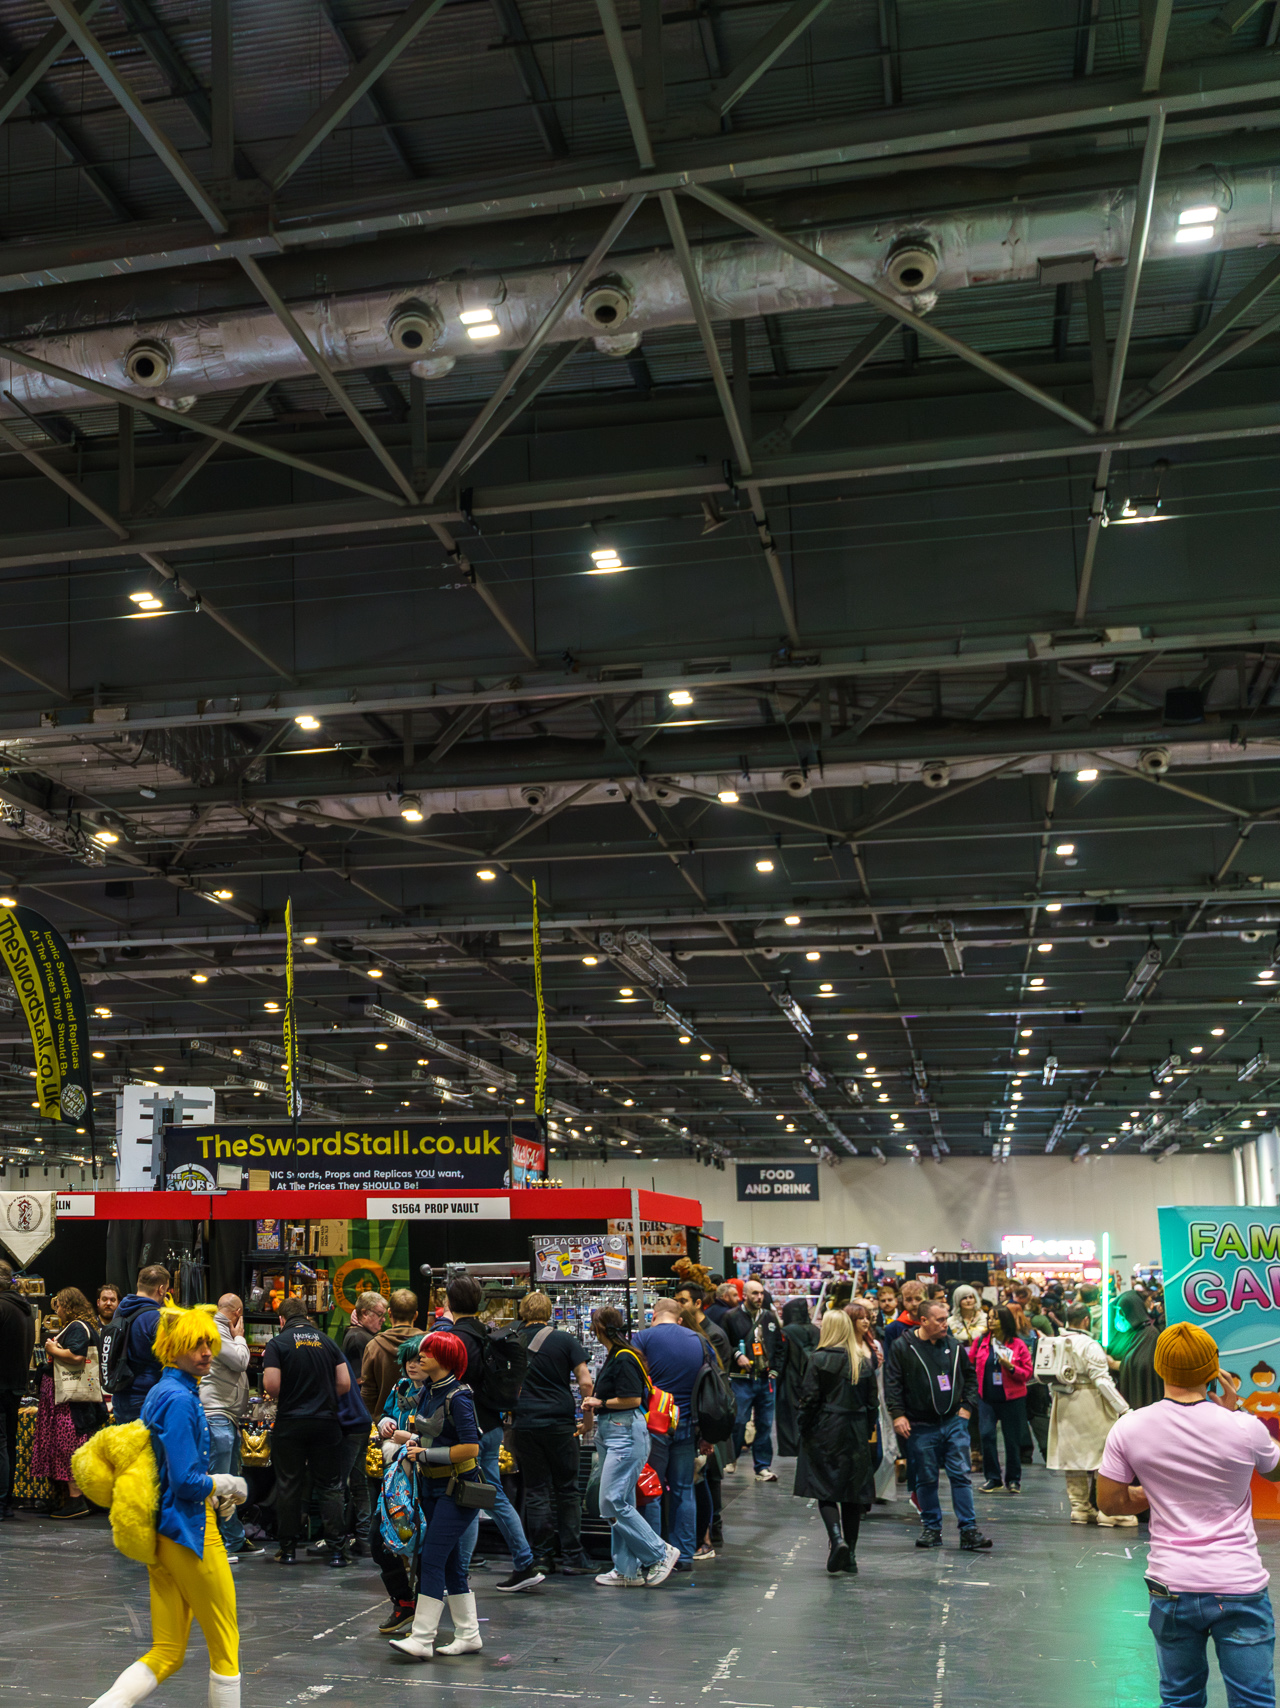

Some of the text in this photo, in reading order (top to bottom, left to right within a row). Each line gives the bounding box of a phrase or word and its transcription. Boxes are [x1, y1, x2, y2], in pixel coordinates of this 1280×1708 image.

[29, 930, 68, 1077] At The Prices They Should Be
[43, 931, 80, 1070] Iconic Swords and Replicas
[197, 1130, 502, 1159] TheSwordStall.co.uk
[324, 1170, 351, 1180] Props
[352, 1170, 371, 1178] and
[373, 1170, 412, 1180] Replicas
[414, 1170, 436, 1179] YOU
[437, 1170, 465, 1179] want,
[760, 1169, 796, 1180] FOOD
[276, 1181, 419, 1190] At The Prices They SHOULD Be!
[744, 1183, 812, 1194] AND DRINK
[392, 1203, 480, 1214] S1564 PROP VAULT
[539, 1236, 607, 1246] ID FACTORY
[101, 1335, 112, 1386] adidas
